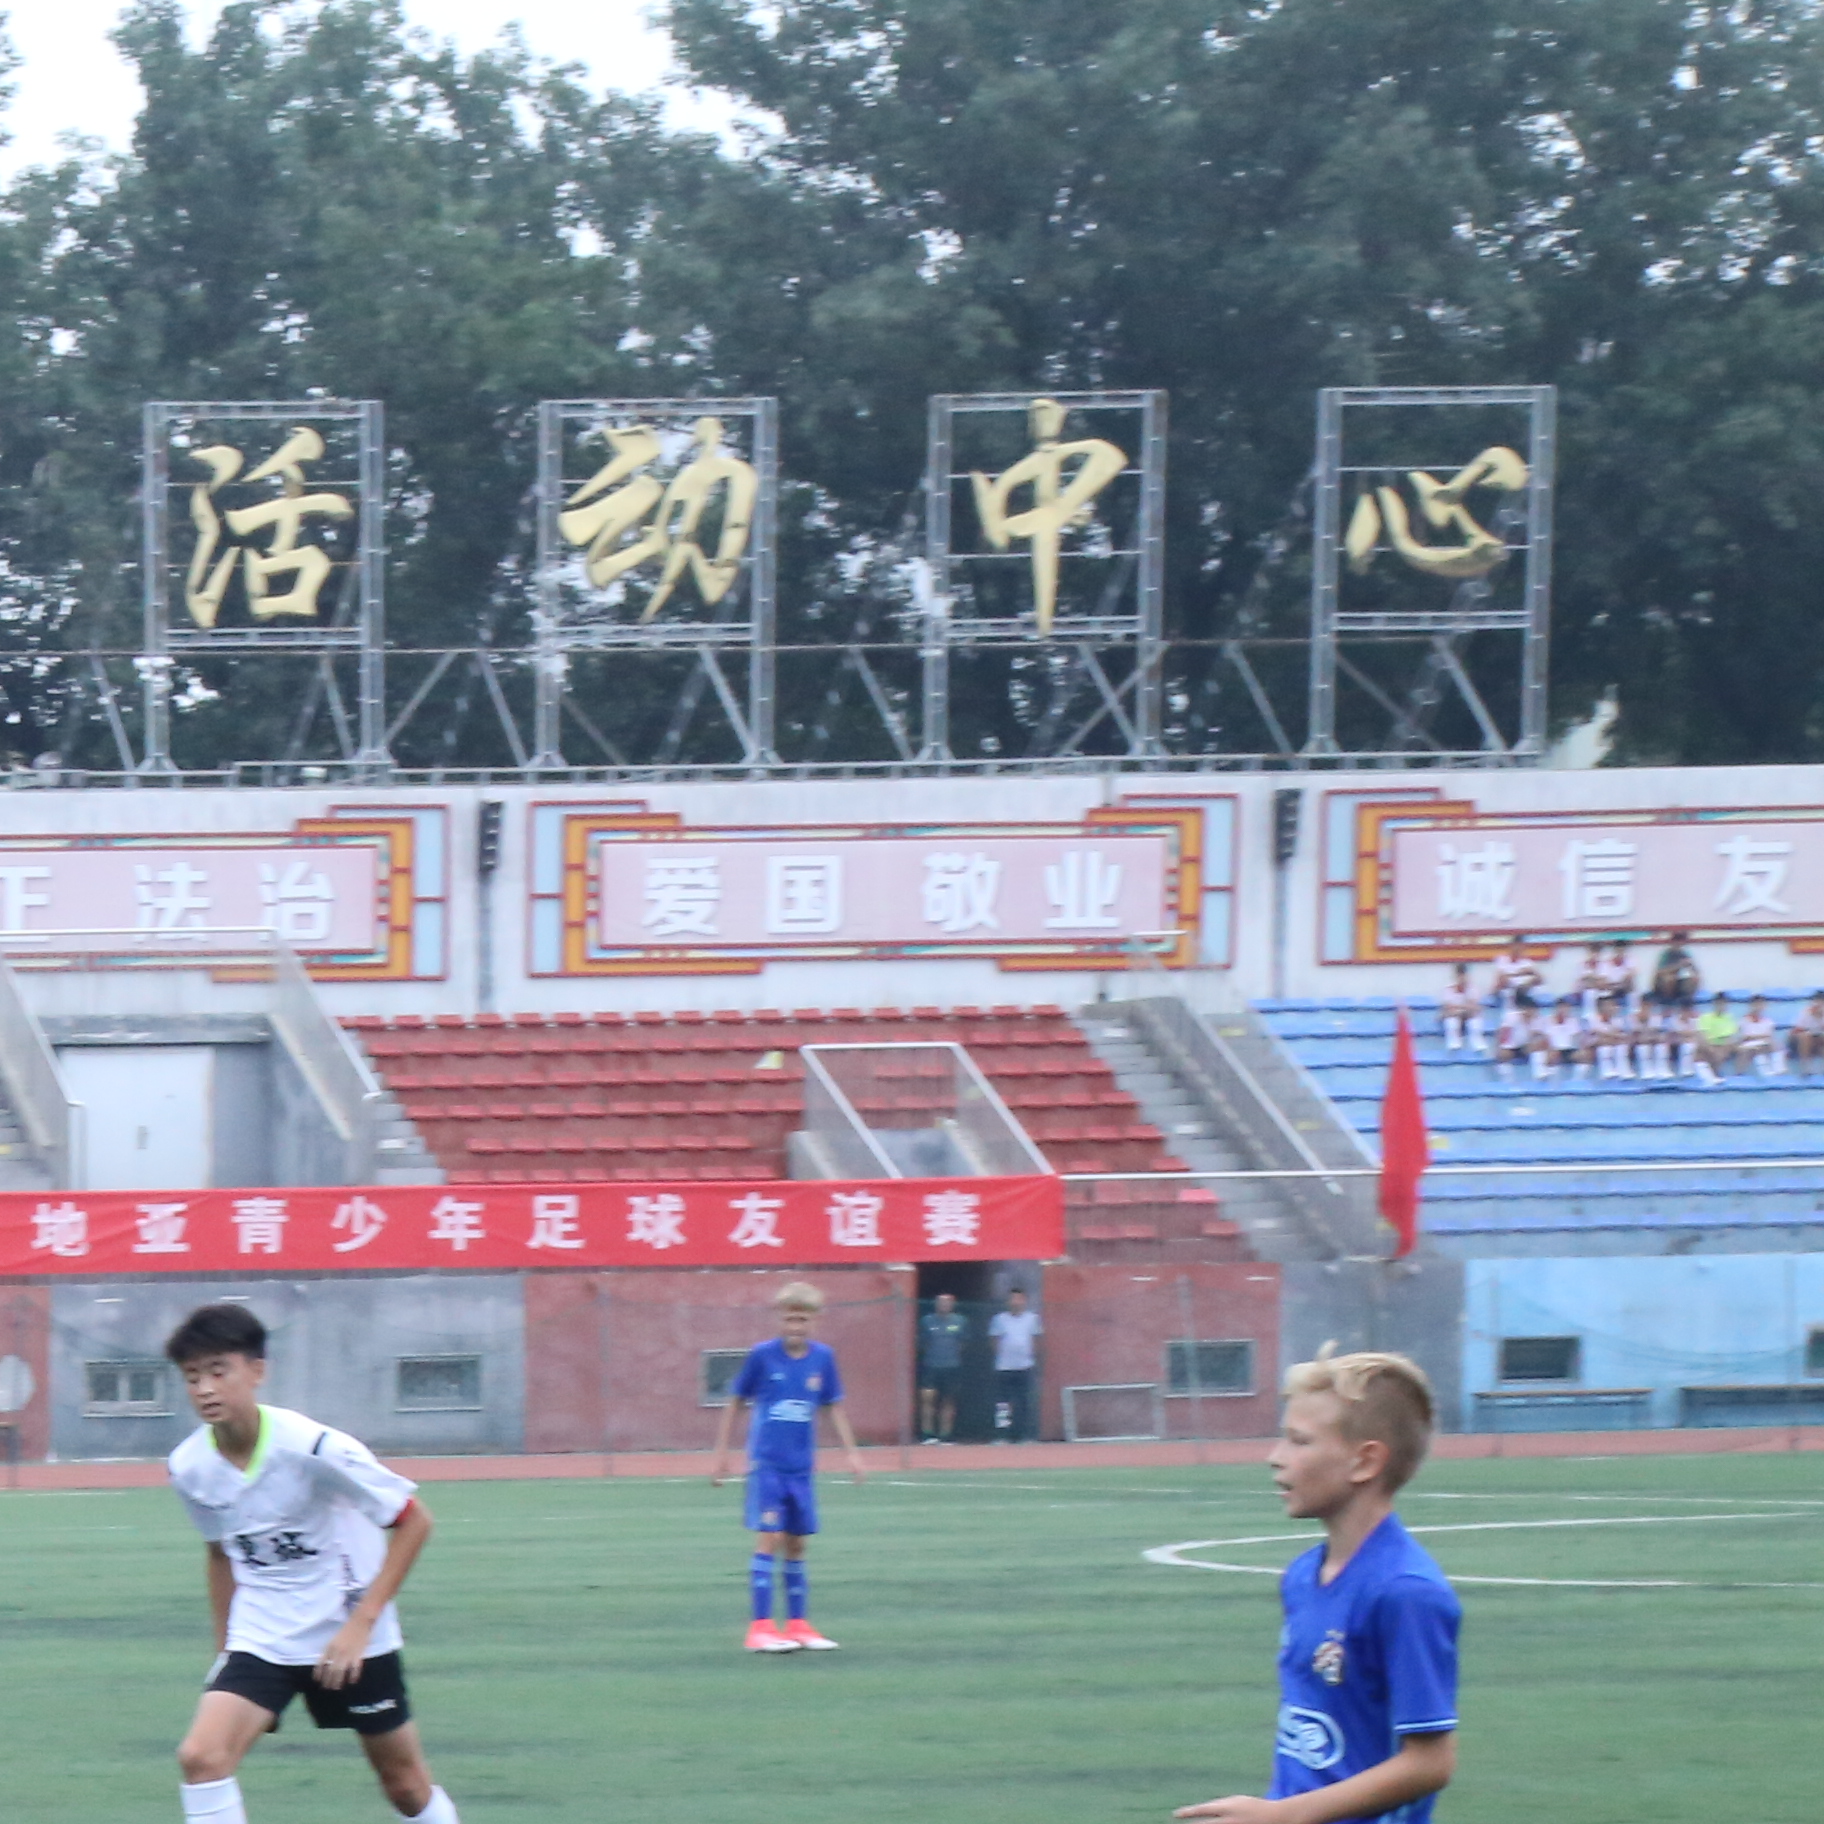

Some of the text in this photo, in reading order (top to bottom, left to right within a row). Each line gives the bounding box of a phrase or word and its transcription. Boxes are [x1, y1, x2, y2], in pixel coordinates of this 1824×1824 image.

[642, 849, 1122, 936] 爱国敬业
[1435, 833, 1794, 921] 诚信友
